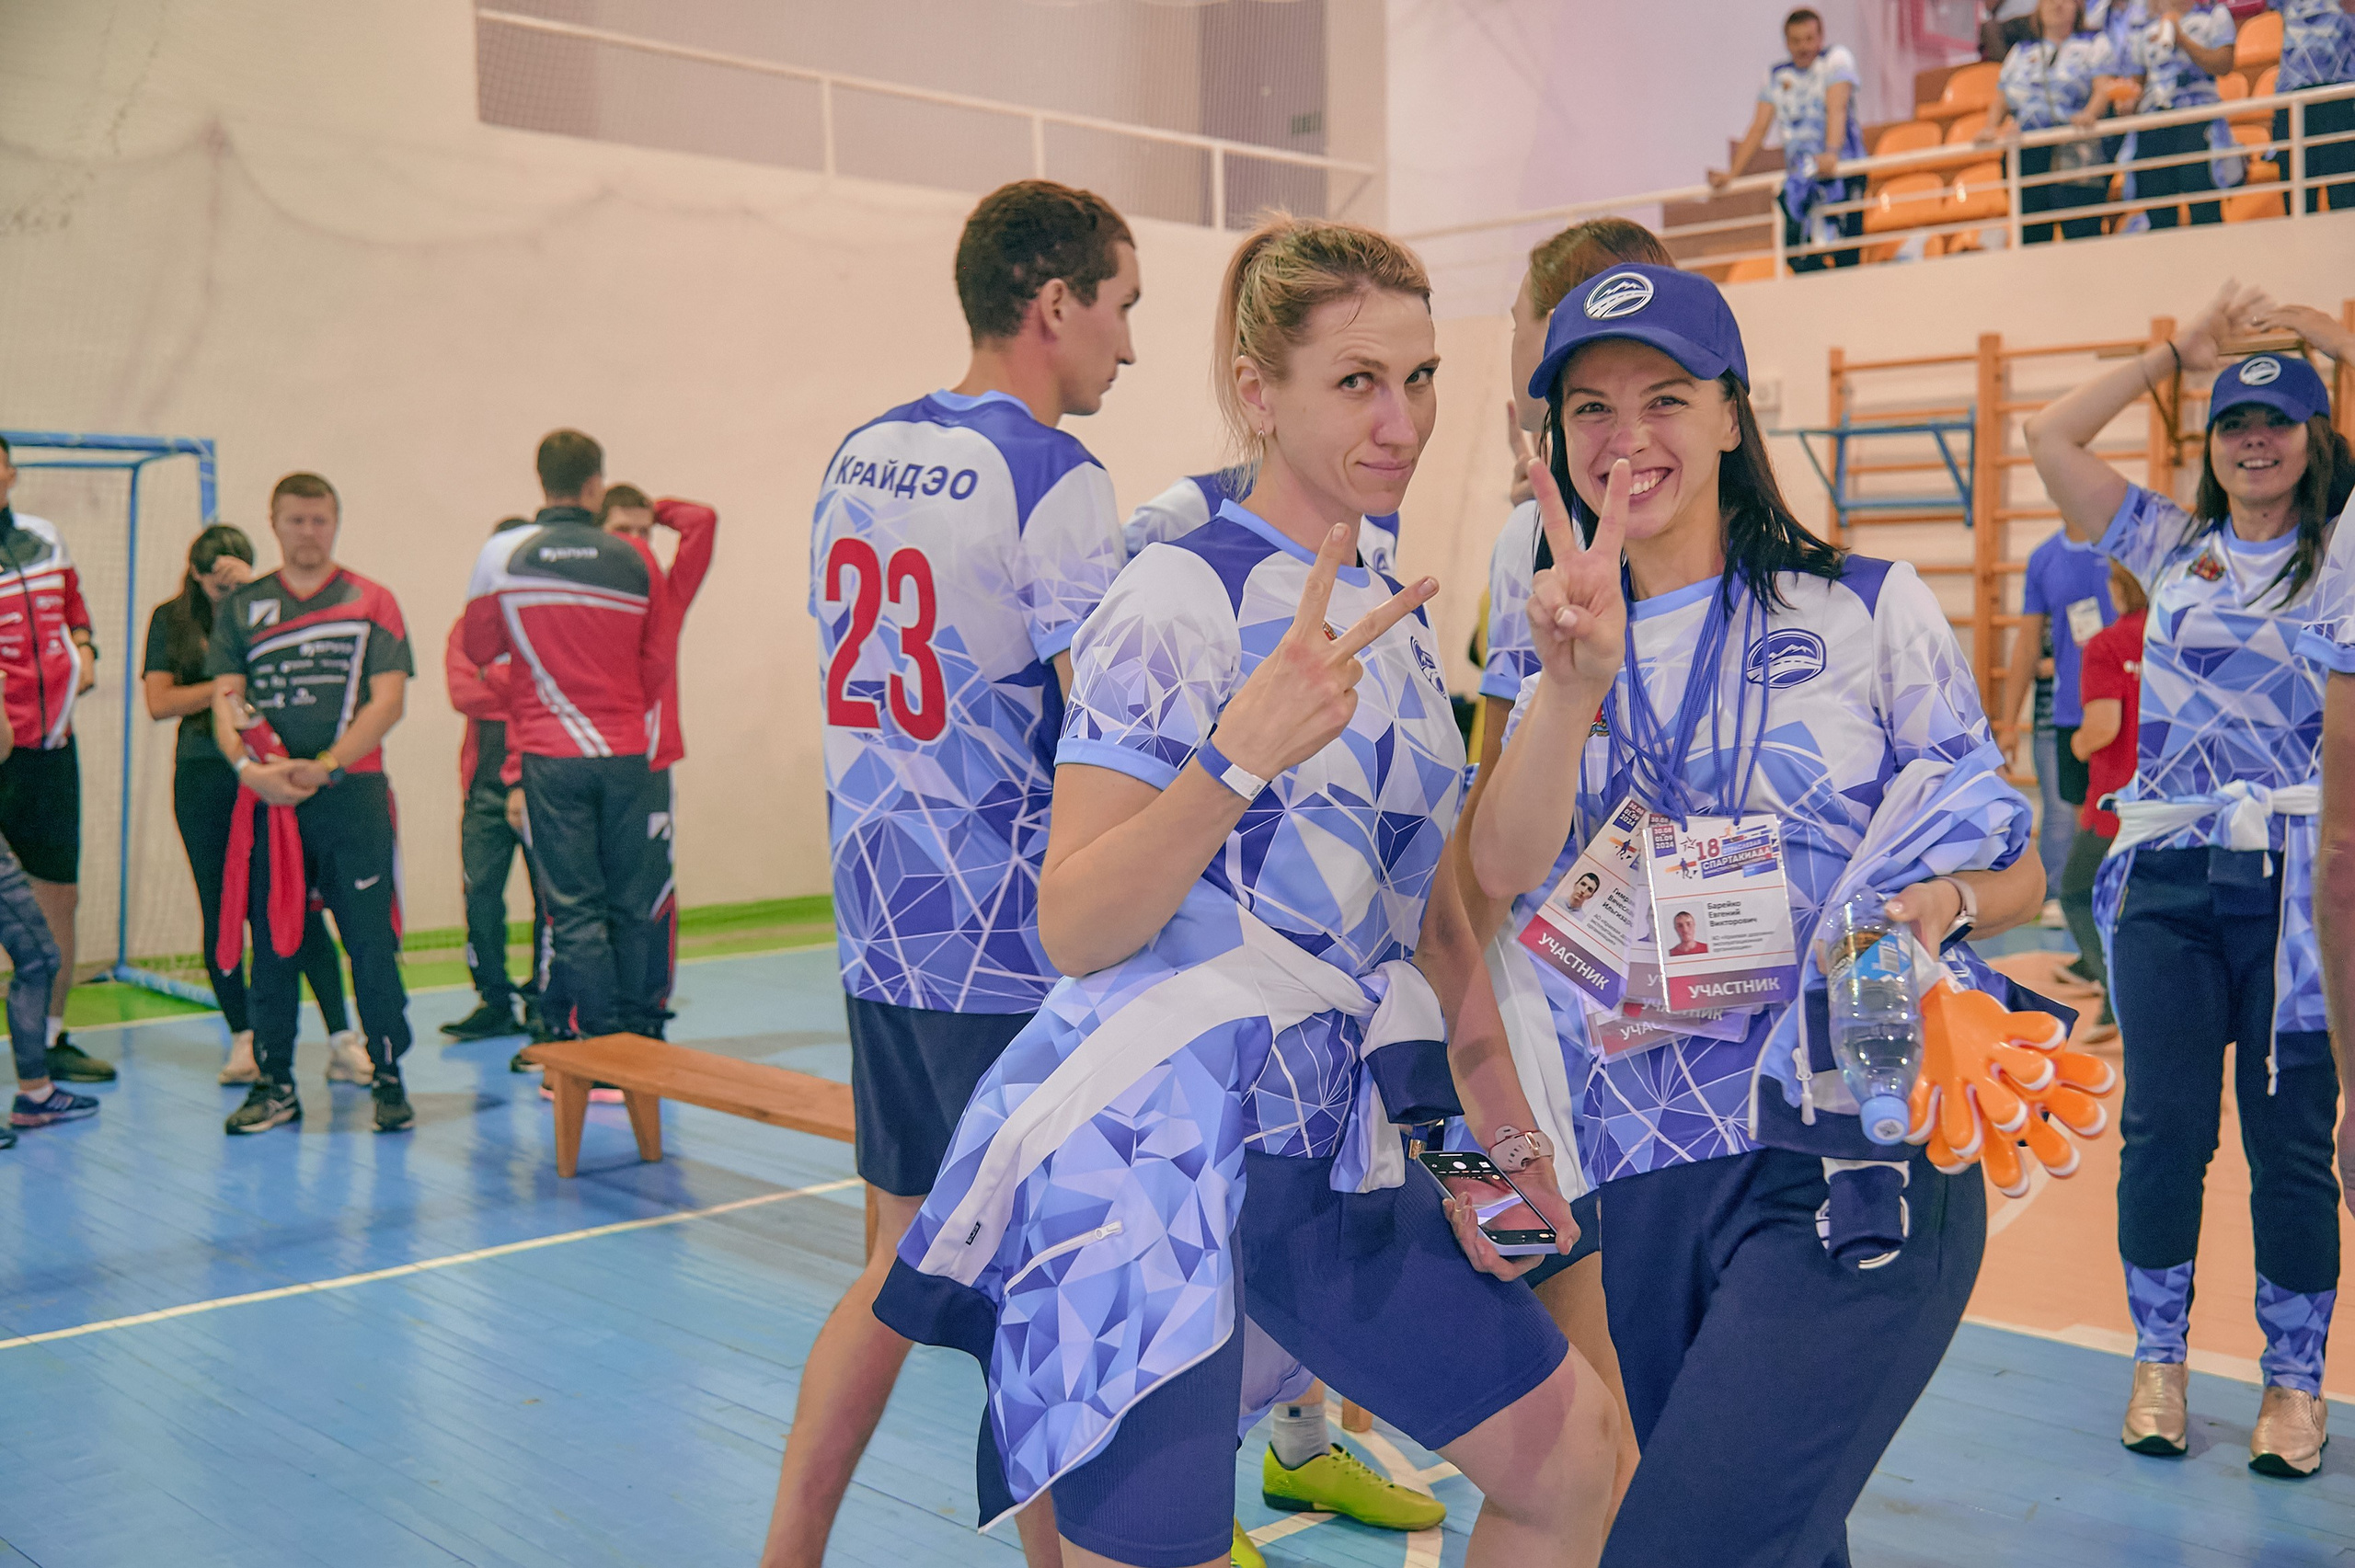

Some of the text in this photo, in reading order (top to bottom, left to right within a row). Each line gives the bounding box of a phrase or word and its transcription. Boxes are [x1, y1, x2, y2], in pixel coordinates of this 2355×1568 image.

[825, 537, 947, 741] 23
[1619, 813, 1637, 827] 2024
[1624, 808, 1639, 821] 01.09
[1655, 841, 1674, 850] 2024
[1696, 838, 1720, 861] 18
[1702, 846, 1772, 870] СПАРТАКИАДА
[1707, 900, 1741, 910] Барейко
[1708, 909, 1741, 919] Евгений
[1709, 918, 1758, 928] Викторович
[1538, 932, 1610, 990] УЧАСТНИК
[1687, 977, 1781, 999] УЧАСТНИК
